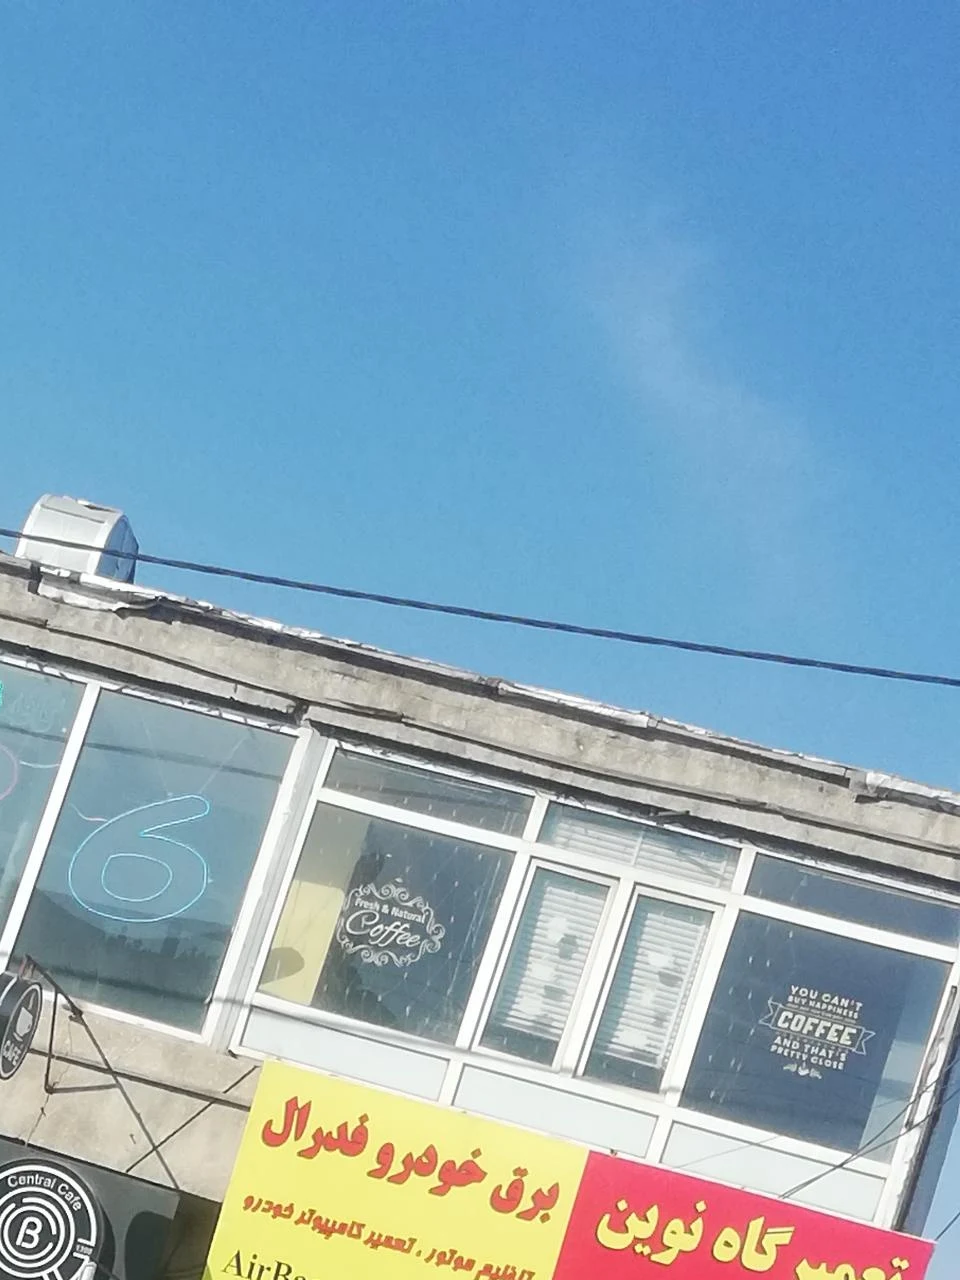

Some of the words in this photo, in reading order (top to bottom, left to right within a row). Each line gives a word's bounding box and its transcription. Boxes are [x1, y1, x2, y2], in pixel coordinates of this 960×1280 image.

[67, 794, 211, 923] 6
[345, 909, 421, 948] Coffee
[354, 898, 380, 912] Fresh
[381, 904, 390, 914] &
[390, 906, 426, 924] Natural
[787, 995, 807, 1006] BUY
[808, 1001, 859, 1019] HAPPINESS
[791, 985, 818, 1000] YOU
[821, 993, 863, 1011] CAN'T
[777, 1010, 857, 1046] COFFEE
[770, 1045, 808, 1061] PRETTY
[810, 1056, 845, 1070] CLOSE
[774, 1036, 800, 1050] AND
[803, 1043, 847, 1062] THAT'S
[7, 1173, 57, 1190] Central
[57, 1183, 82, 1212] Cafe
[489, 1166, 561, 1224] برق
[595, 1198, 708, 1266] نوین
